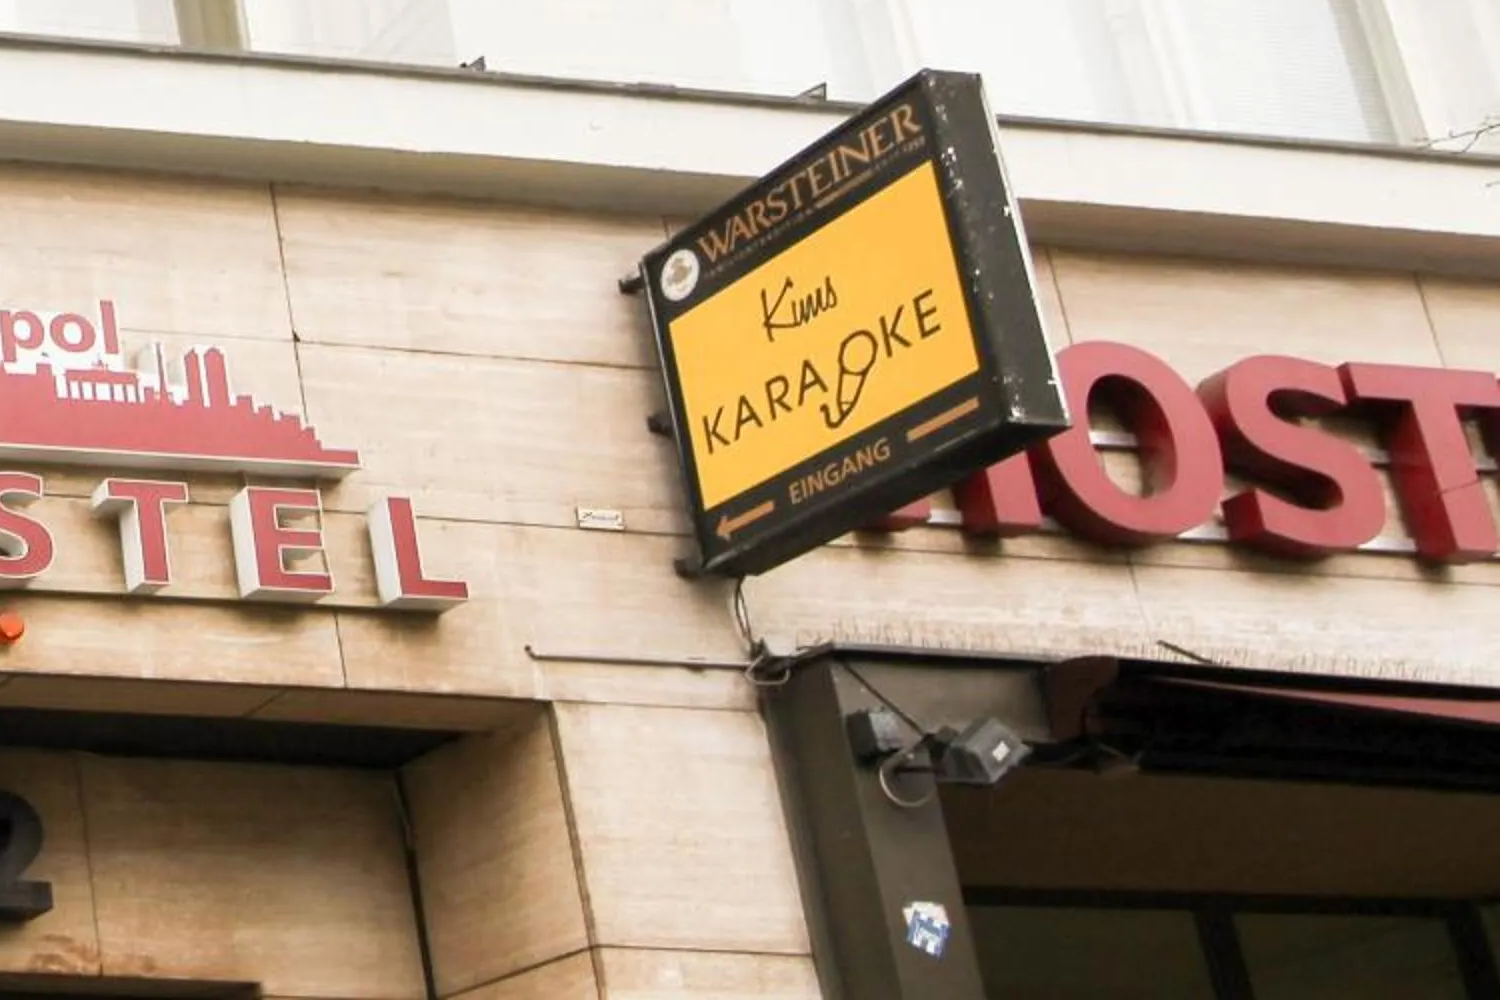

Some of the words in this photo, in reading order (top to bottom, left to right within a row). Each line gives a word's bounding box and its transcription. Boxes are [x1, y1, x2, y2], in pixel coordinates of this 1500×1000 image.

[697, 103, 922, 263] WARSTEINER
[702, 288, 942, 455] KARAOKE
[882, 339, 1500, 563] OST
[788, 437, 892, 505] EINGANG
